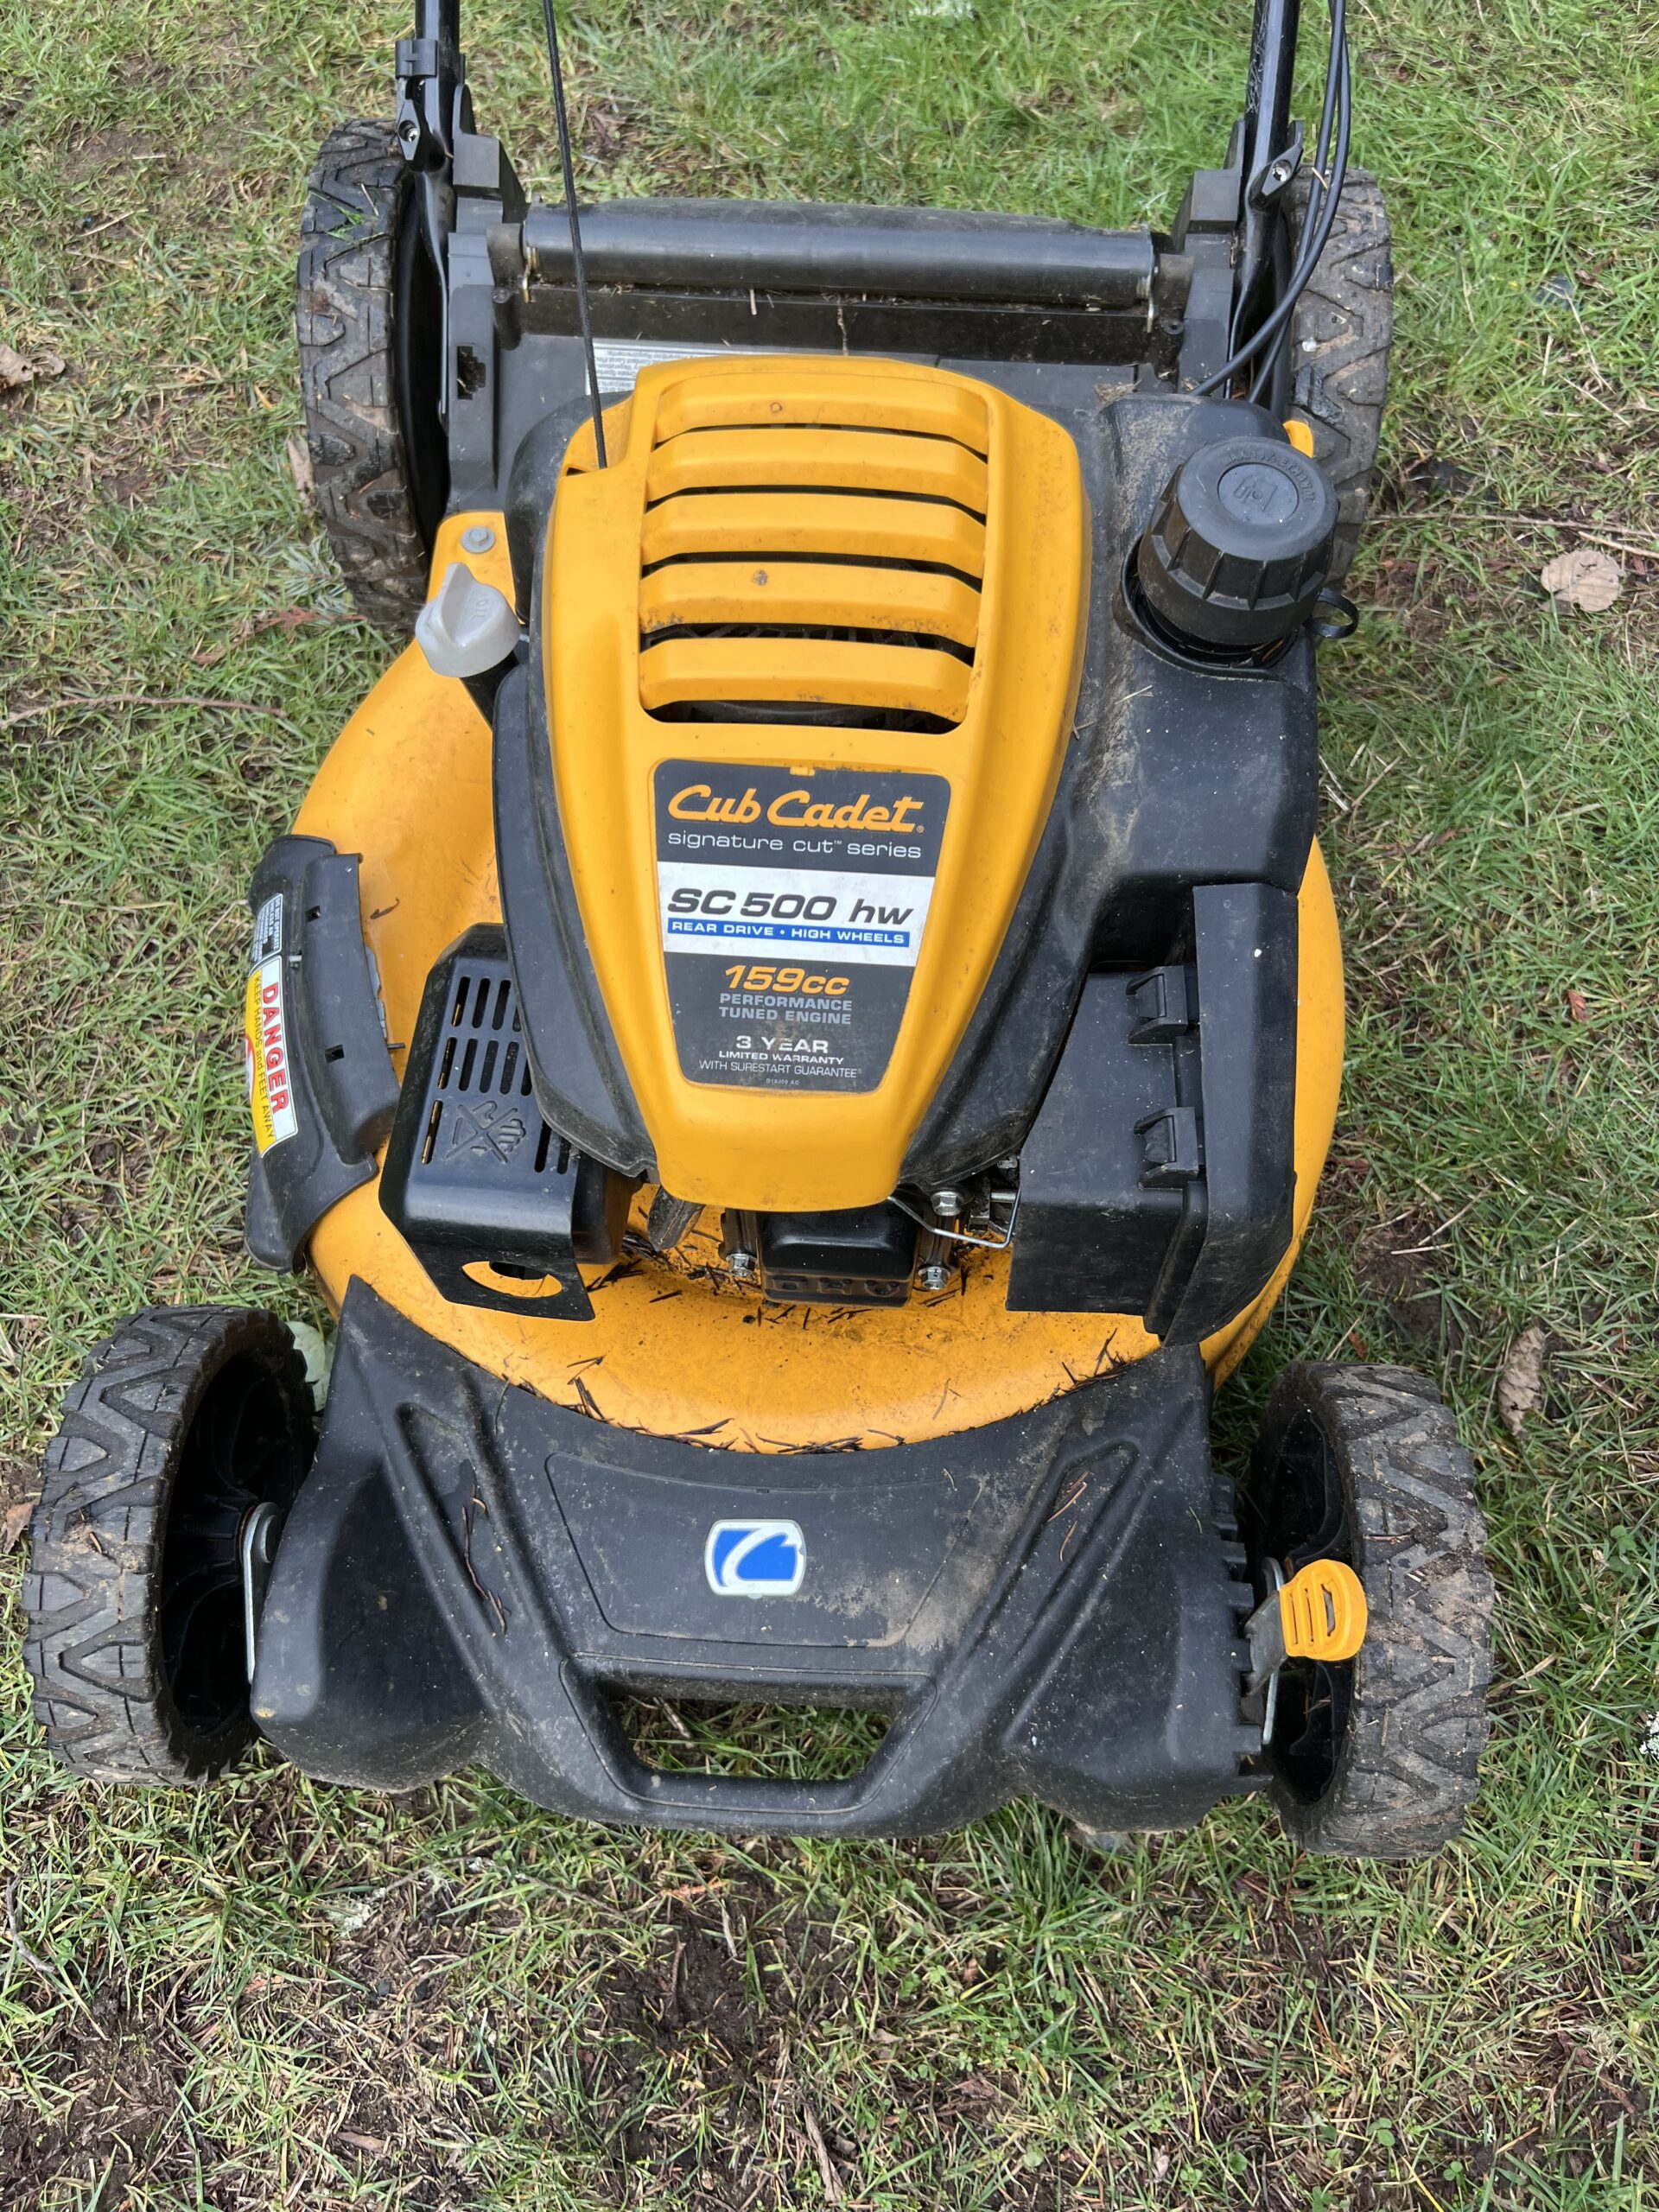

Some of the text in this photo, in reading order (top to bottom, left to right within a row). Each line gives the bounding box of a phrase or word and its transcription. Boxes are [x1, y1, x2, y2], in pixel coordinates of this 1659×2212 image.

[668, 784, 761, 823] Cub
[668, 830, 784, 851] signature
[847, 842, 921, 858] series
[740, 892, 837, 921] 500
[849, 898, 914, 925] hw
[671, 921, 905, 944] REAR DRIVE HIGH WHEELS
[724, 964, 850, 995] 159cc
[720, 993, 853, 1011] PERFORMANCE
[719, 1006, 851, 1025] TUNED ENGINE
[263, 982, 289, 1115] DANGER
[736, 1035, 829, 1053] 3 YEAR
[256, 1051, 264, 1070] and
[699, 1059, 728, 1071] WITH
[730, 1062, 791, 1075] SURESTART
[719, 1051, 844, 1065] LIMITED WARRANTY
[258, 1071, 269, 1101] FEET
[262, 1105, 275, 1138] AWAY
